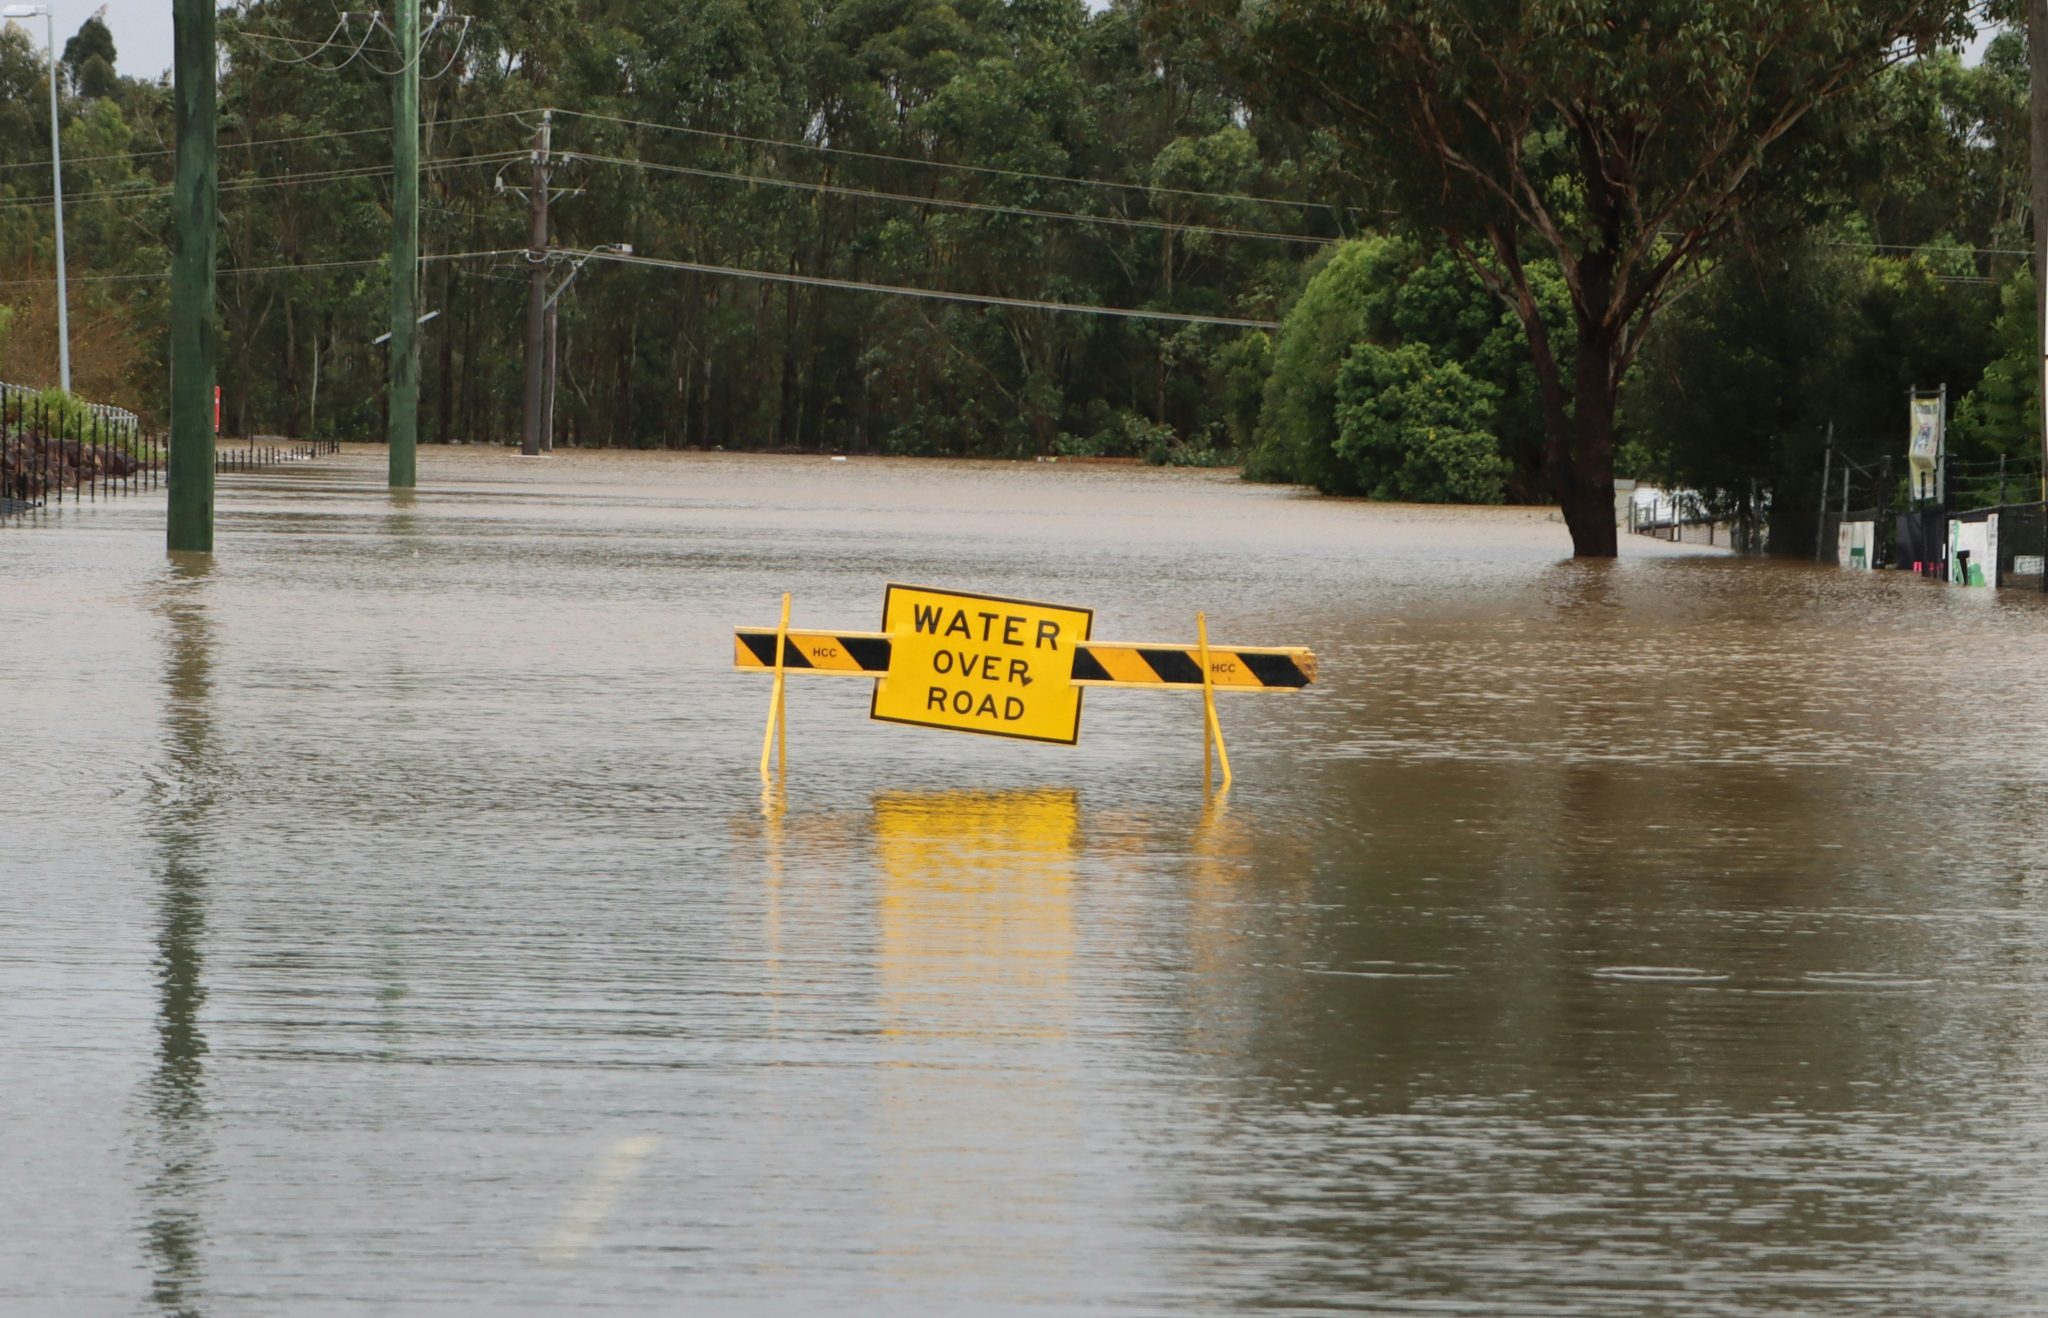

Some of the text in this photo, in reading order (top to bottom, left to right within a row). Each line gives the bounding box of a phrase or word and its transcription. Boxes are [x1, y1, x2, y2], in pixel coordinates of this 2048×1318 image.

[914, 604, 1061, 651] WATER
[813, 647, 837, 657] HCC
[933, 649, 1031, 687] OVER
[1212, 663, 1236, 673] HCC
[927, 686, 1025, 721] ROAD
